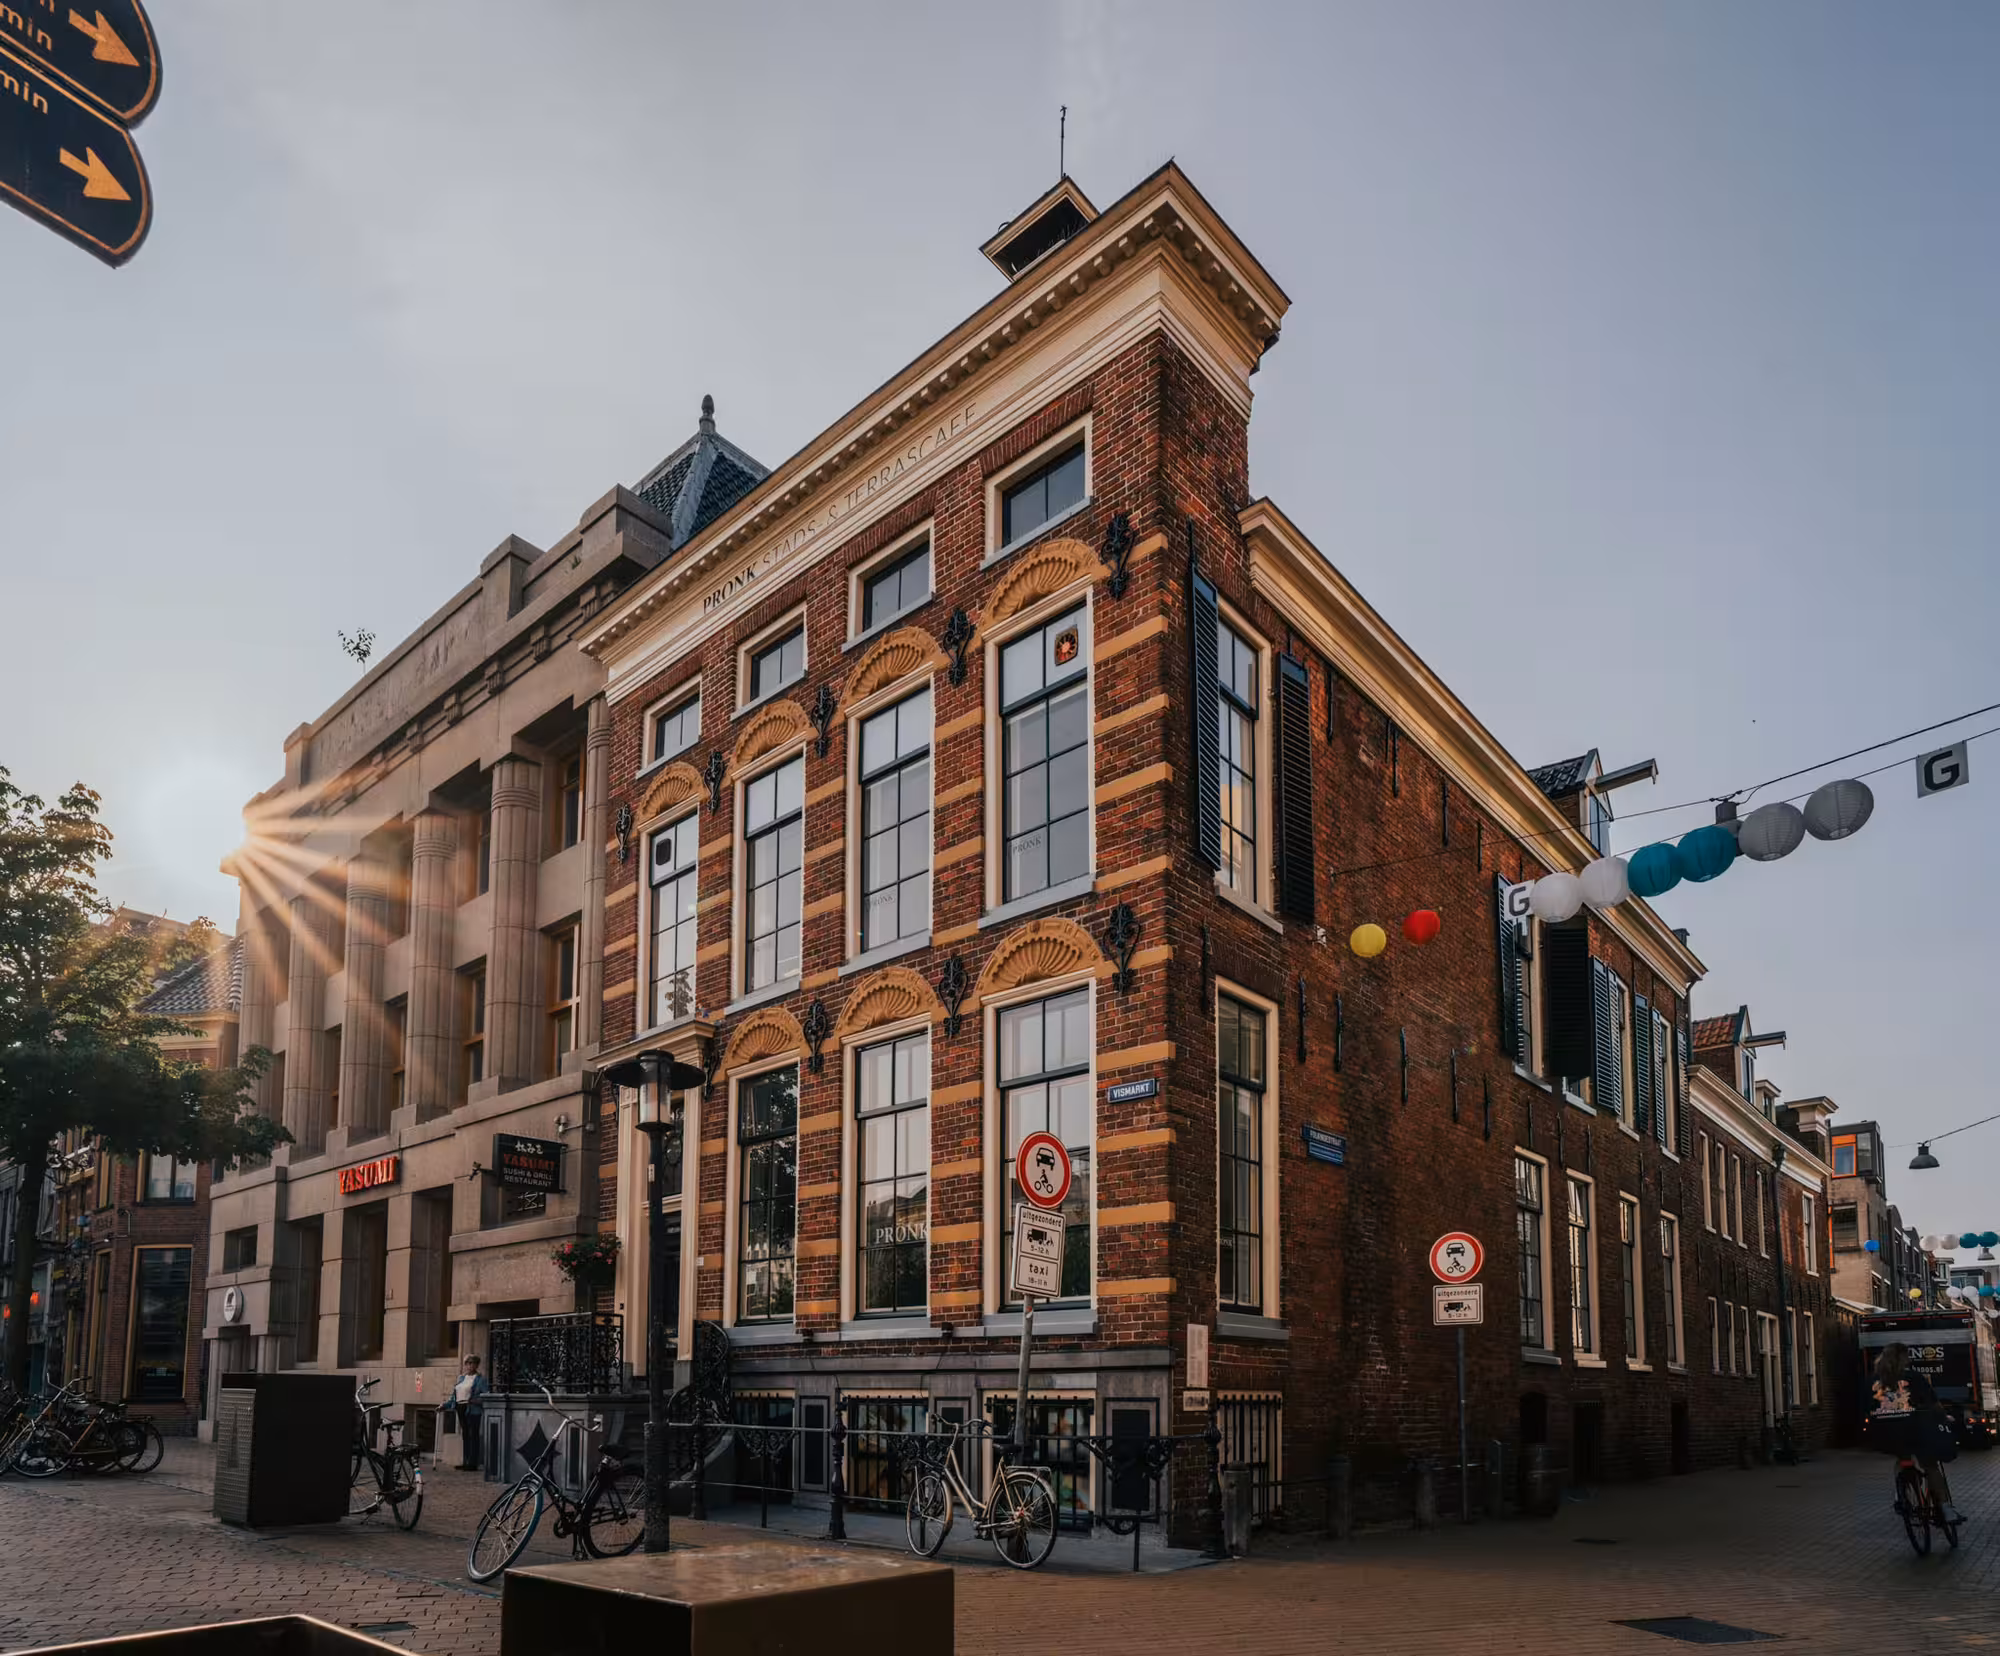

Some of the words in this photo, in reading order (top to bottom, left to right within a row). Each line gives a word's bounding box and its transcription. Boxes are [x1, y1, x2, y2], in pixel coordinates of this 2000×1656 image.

[0, 2, 52, 51] min
[703, 561, 757, 614] PRONK
[1924, 750, 1960, 791] G
[1509, 886, 1530, 917] G
[1113, 1083, 1150, 1098] VISMARKT
[503, 1154, 555, 1170] YASUMI
[338, 1156, 397, 1195] YASUMI
[503, 1167, 526, 1177] SUSHI
[533, 1172, 554, 1181] GRILL
[504, 1175, 552, 1187] RESTAURANT
[1022, 1211, 1062, 1227] uitgezonderd
[876, 1222, 928, 1244] PRONK
[1029, 1263, 1049, 1276] taxi
[1438, 1289, 1478, 1298] uitgezonderd
